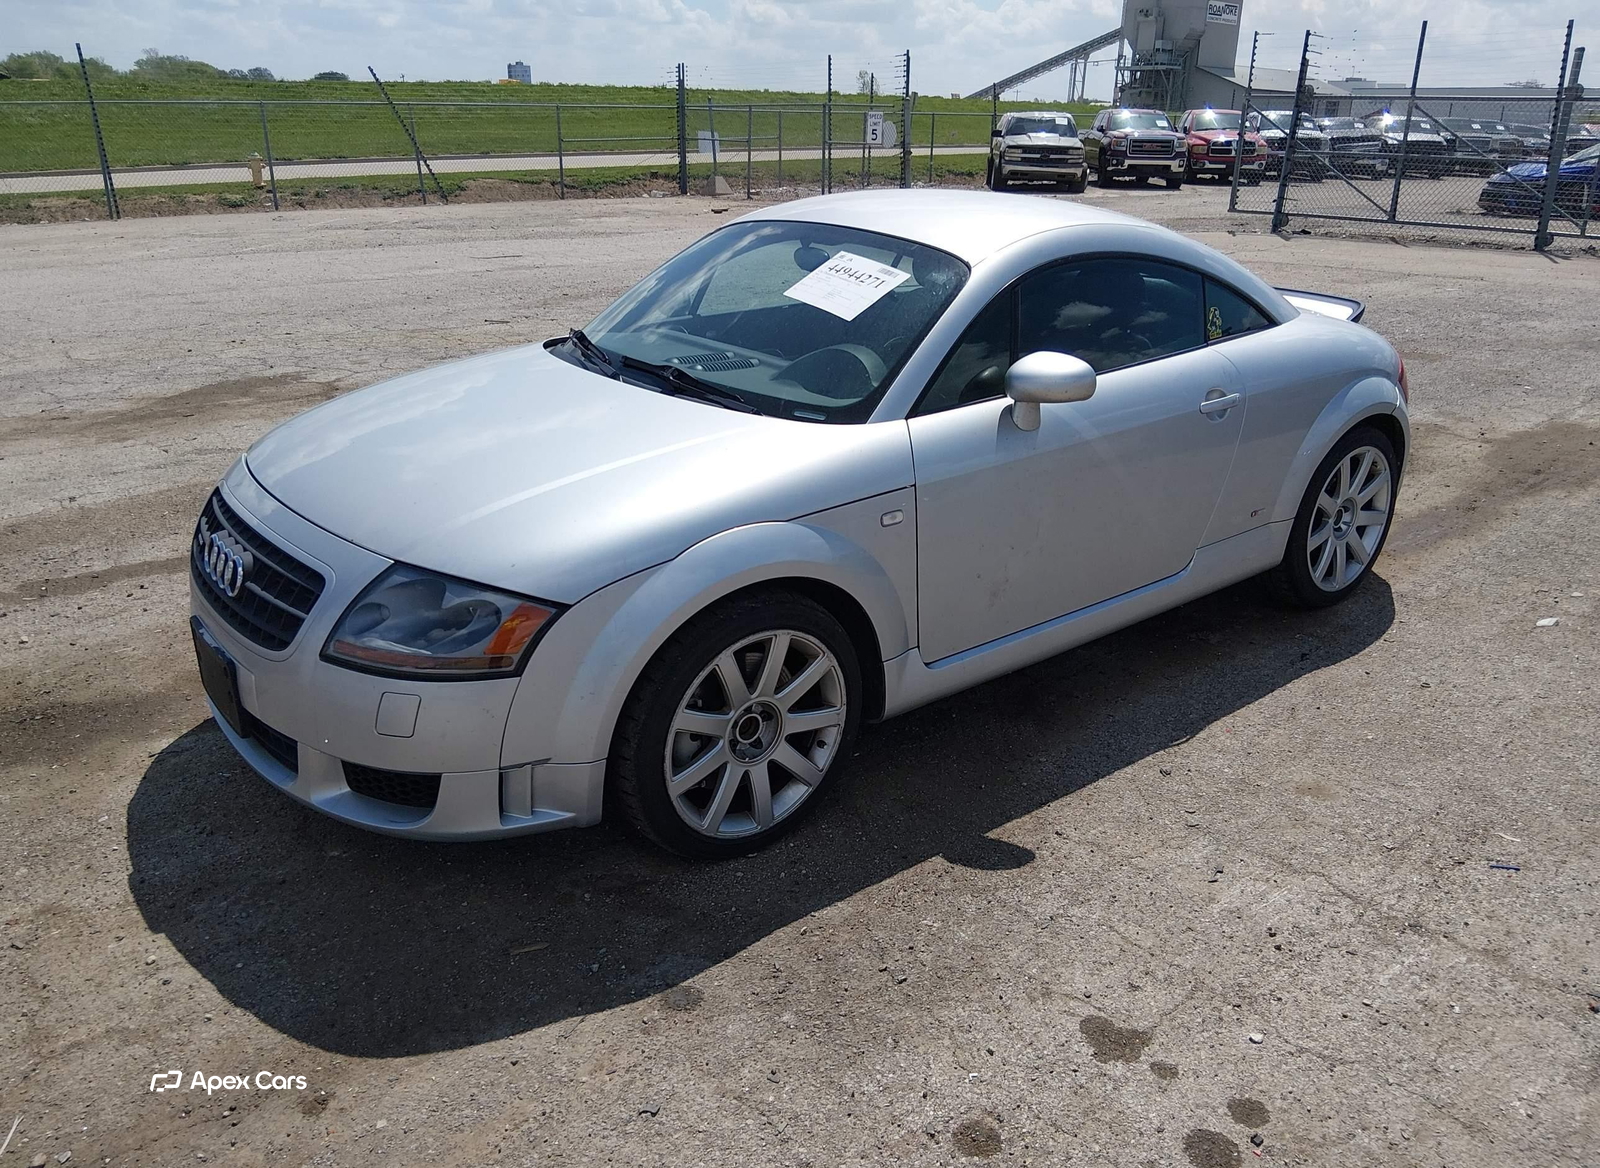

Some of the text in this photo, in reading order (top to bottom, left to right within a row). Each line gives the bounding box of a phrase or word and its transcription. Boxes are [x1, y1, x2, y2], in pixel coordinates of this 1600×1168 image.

[1209, 4, 1238, 16] ROANOKE
[871, 129, 878, 141] 5
[828, 263, 887, 289] 44944271
